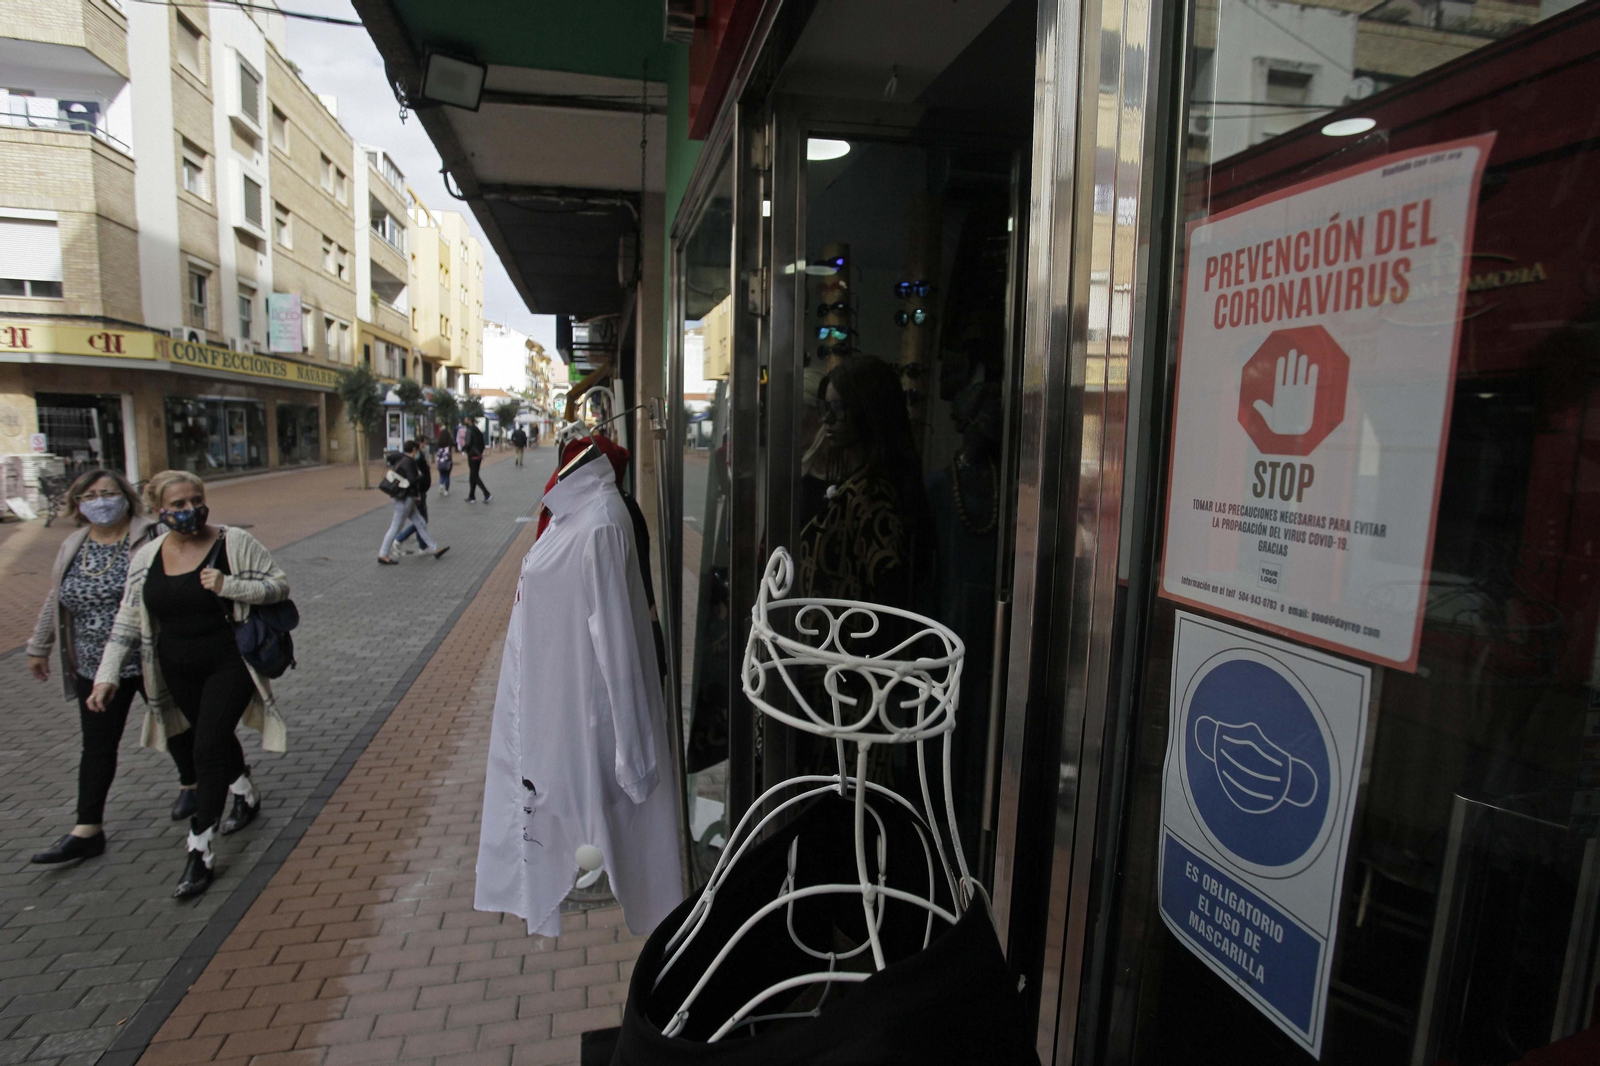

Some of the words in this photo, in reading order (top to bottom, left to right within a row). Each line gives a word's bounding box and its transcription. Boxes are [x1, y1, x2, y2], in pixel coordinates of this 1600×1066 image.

[1204, 212, 1365, 292] PREVENCIÓN
[1374, 198, 1438, 257] DEL
[1213, 256, 1412, 330] CORONAVIRUS
[172, 342, 288, 377] CONFECCIONES
[1252, 460, 1315, 503] STOP
[1193, 498, 1214, 512] TOMAR
[1214, 501, 1227, 514] LAS
[1228, 503, 1278, 522] PRECAUCIONES
[1279, 510, 1326, 529] NECESARIAS
[1328, 517, 1351, 533] PARA
[1353, 520, 1387, 538] EVITAR
[1212, 516, 1220, 528] LA
[1221, 517, 1267, 536] PROPAGACIÓN
[1269, 526, 1281, 539] DEL
[1283, 528, 1306, 544] VIRUS
[1258, 540, 1288, 557] GRACIAS
[1260, 575, 1278, 585] LOGO
[1261, 567, 1279, 577] YOUR
[1181, 576, 1210, 593] Información
[1211, 585, 1219, 594] en
[1219, 585, 1225, 596] el
[1288, 604, 1309, 619] email:
[1185, 859, 1200, 883] ES
[1202, 874, 1285, 945] OBLIGATORIO
[1197, 893, 1212, 917] EL
[1214, 904, 1240, 938] USO
[1243, 926, 1262, 954] DE
[1188, 912, 1266, 986] MASCARILLA
